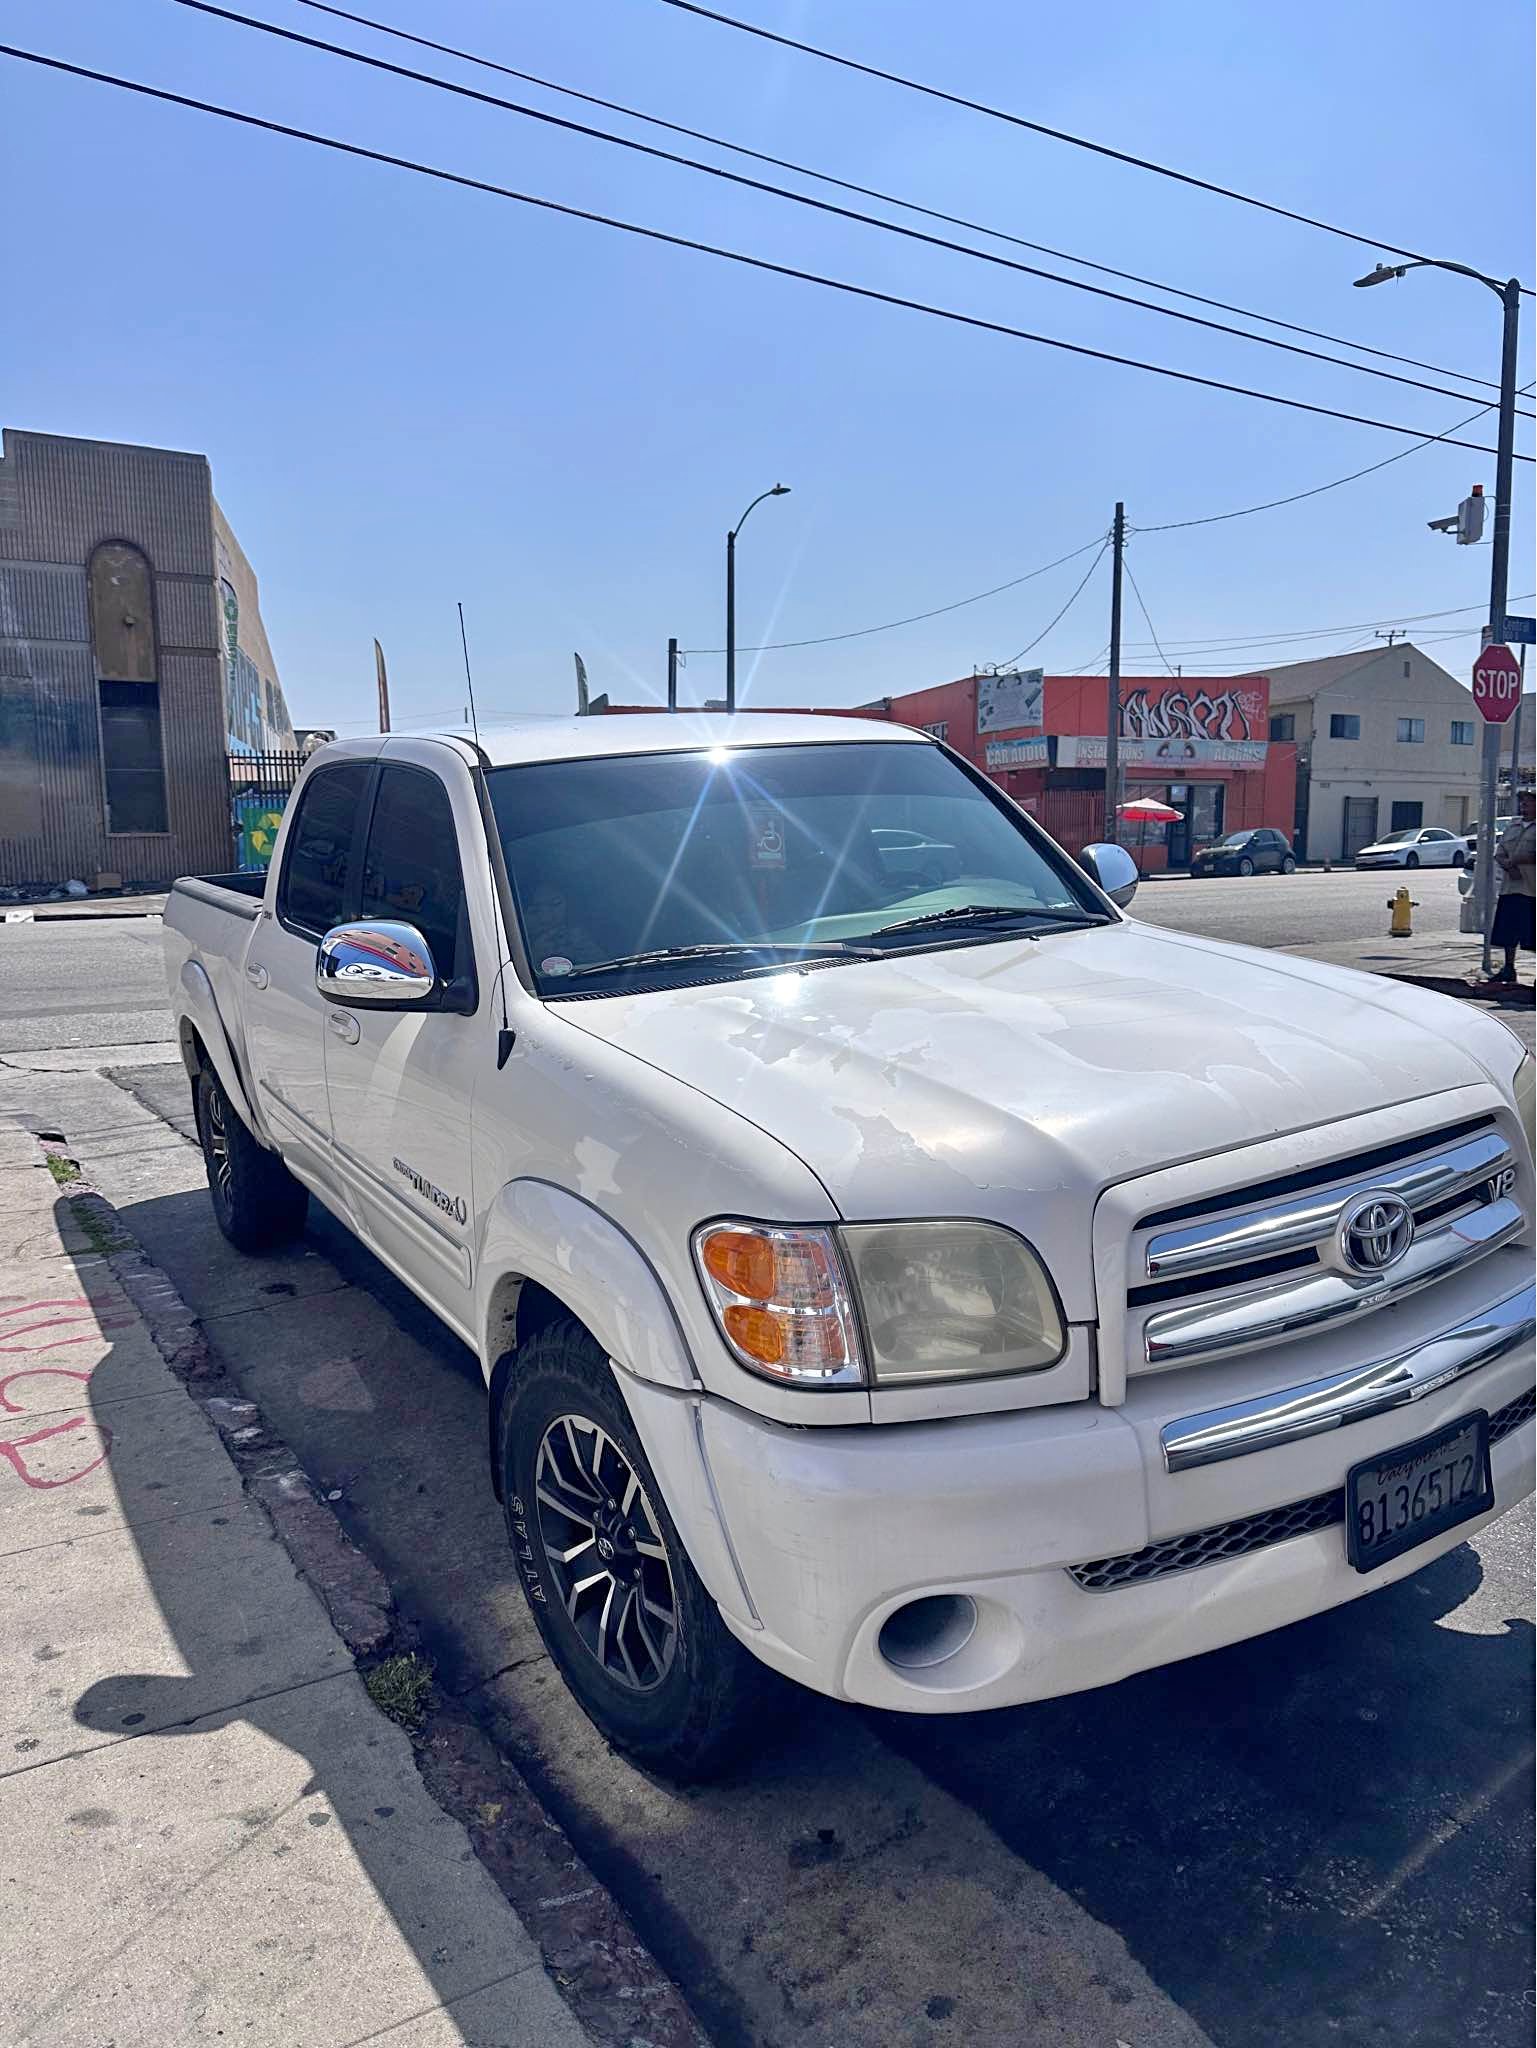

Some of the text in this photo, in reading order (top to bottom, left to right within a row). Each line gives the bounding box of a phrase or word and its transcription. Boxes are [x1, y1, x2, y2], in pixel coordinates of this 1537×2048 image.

[1476, 669, 1519, 699] STOP
[986, 743, 1047, 766] CAR AUDIO
[1487, 1168, 1516, 1202] V8
[1359, 1454, 1474, 1546] 81365T2
[511, 1495, 547, 1603] ATLAS
